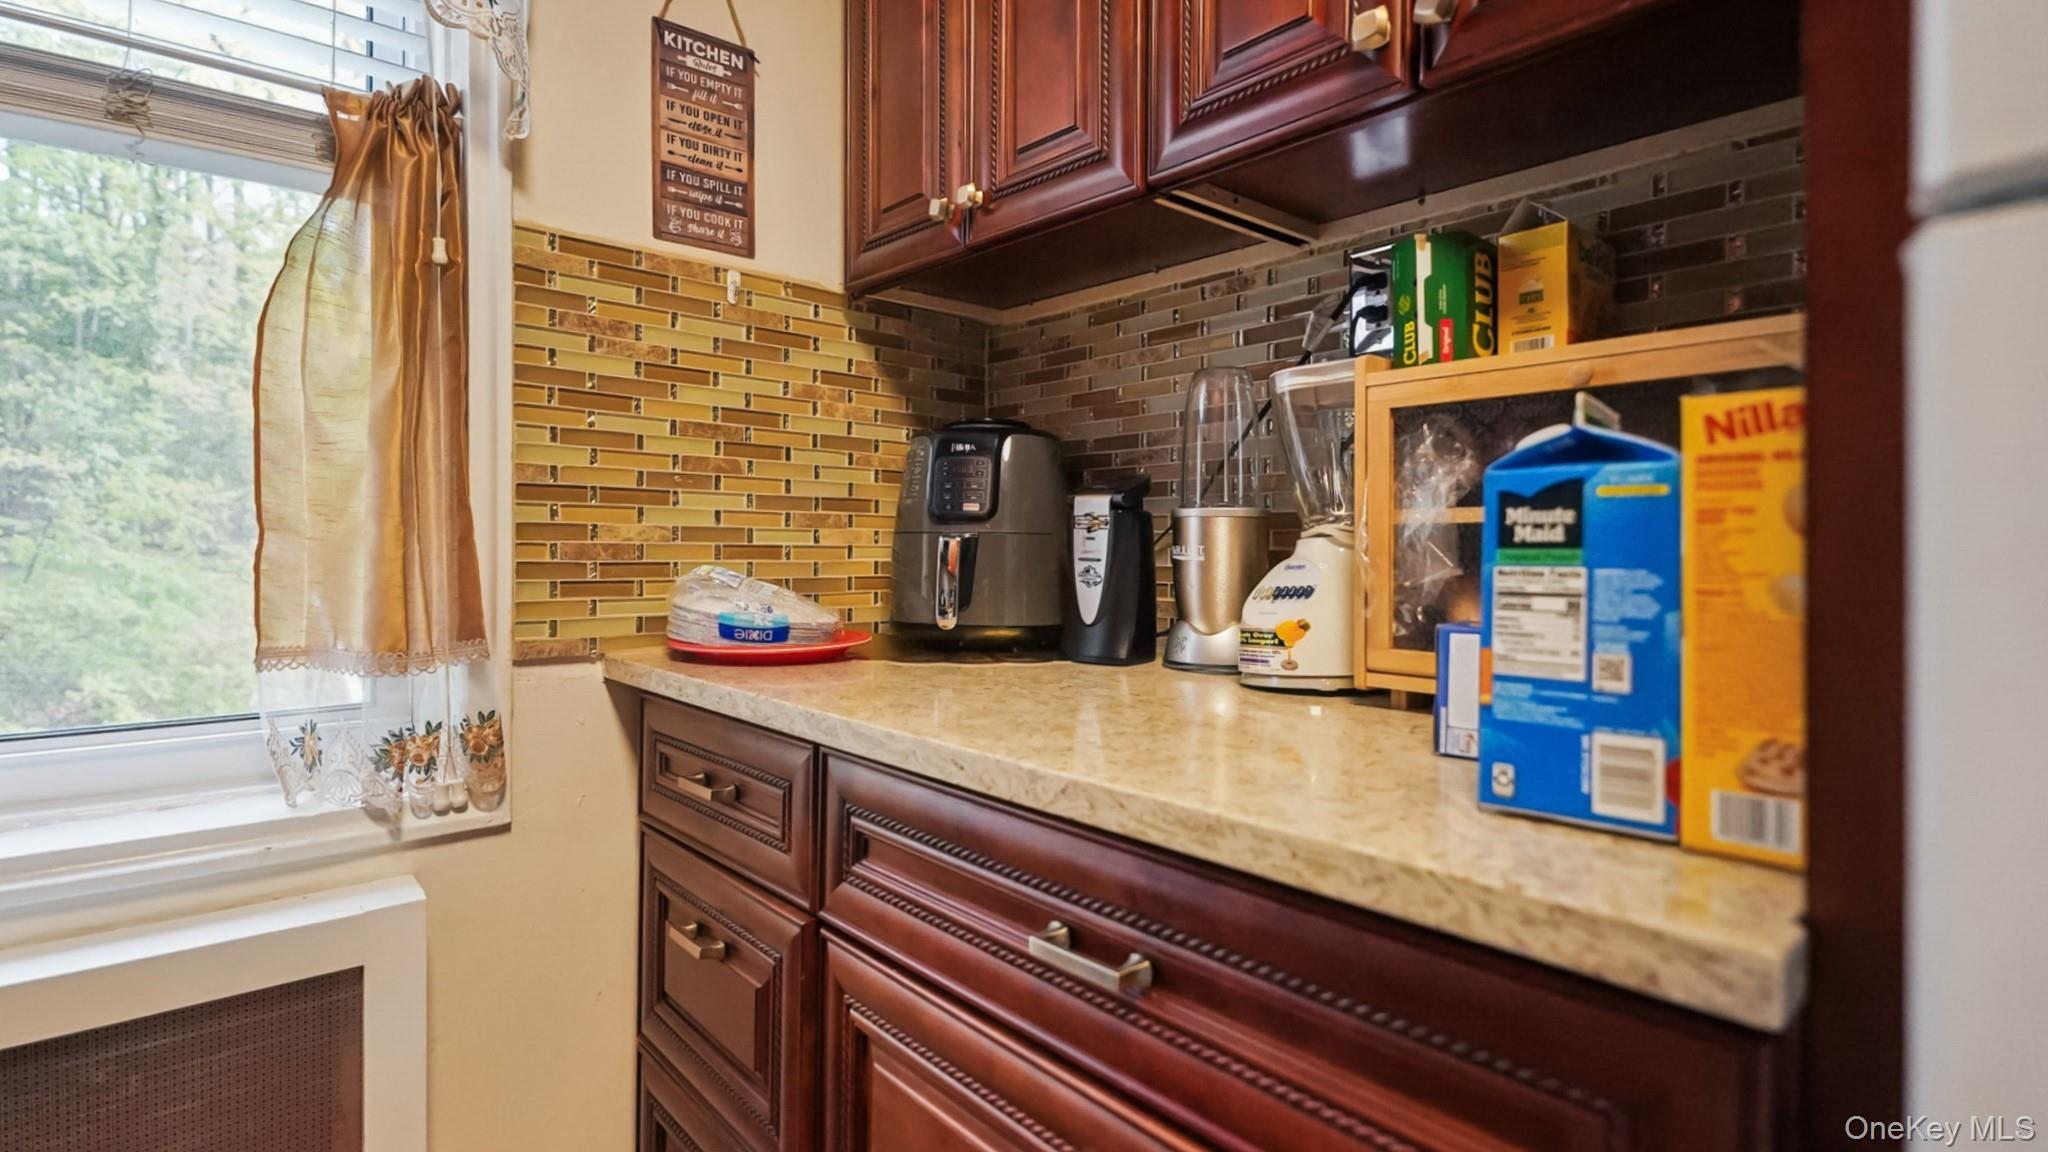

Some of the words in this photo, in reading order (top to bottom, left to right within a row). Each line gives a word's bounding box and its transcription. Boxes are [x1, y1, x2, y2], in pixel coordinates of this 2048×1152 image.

[664, 30, 744, 70] KITCHEN
[666, 65, 676, 77] IF
[677, 69, 698, 84] YOU
[700, 76, 731, 95] EMPTY
[734, 87, 743, 99] IT
[691, 89, 708, 102] fill
[709, 93, 718, 104] it
[666, 100, 676, 111] IF
[679, 103, 700, 118] YOU
[703, 110, 731, 127] OPEN
[733, 119, 743, 130] IT
[687, 121, 713, 135] close
[715, 128, 723, 138] it
[666, 133, 676, 144] IF
[679, 137, 699, 151] YOU
[702, 143, 731, 159] DIRTY
[734, 151, 743, 162] IT
[687, 154, 713, 168] clean
[716, 161, 724, 171] it
[666, 169, 677, 180] IF
[679, 172, 700, 187] YOU
[703, 178, 731, 194] SPILL
[734, 185, 743, 196] IT
[688, 190, 713, 204] wipe
[715, 194, 723, 205] it
[667, 203, 677, 215] IF
[680, 206, 700, 220] YOU
[704, 212, 731, 228] COOK
[734, 219, 743, 229] IT
[687, 223, 714, 236] share
[717, 229, 725, 239] it
[1472, 250, 1495, 357] CLUB
[1403, 320, 1417, 365] CLUB
[1704, 399, 1807, 446] Nilla
[1504, 506, 1577, 526] Minute
[1513, 523, 1566, 544] Maid
